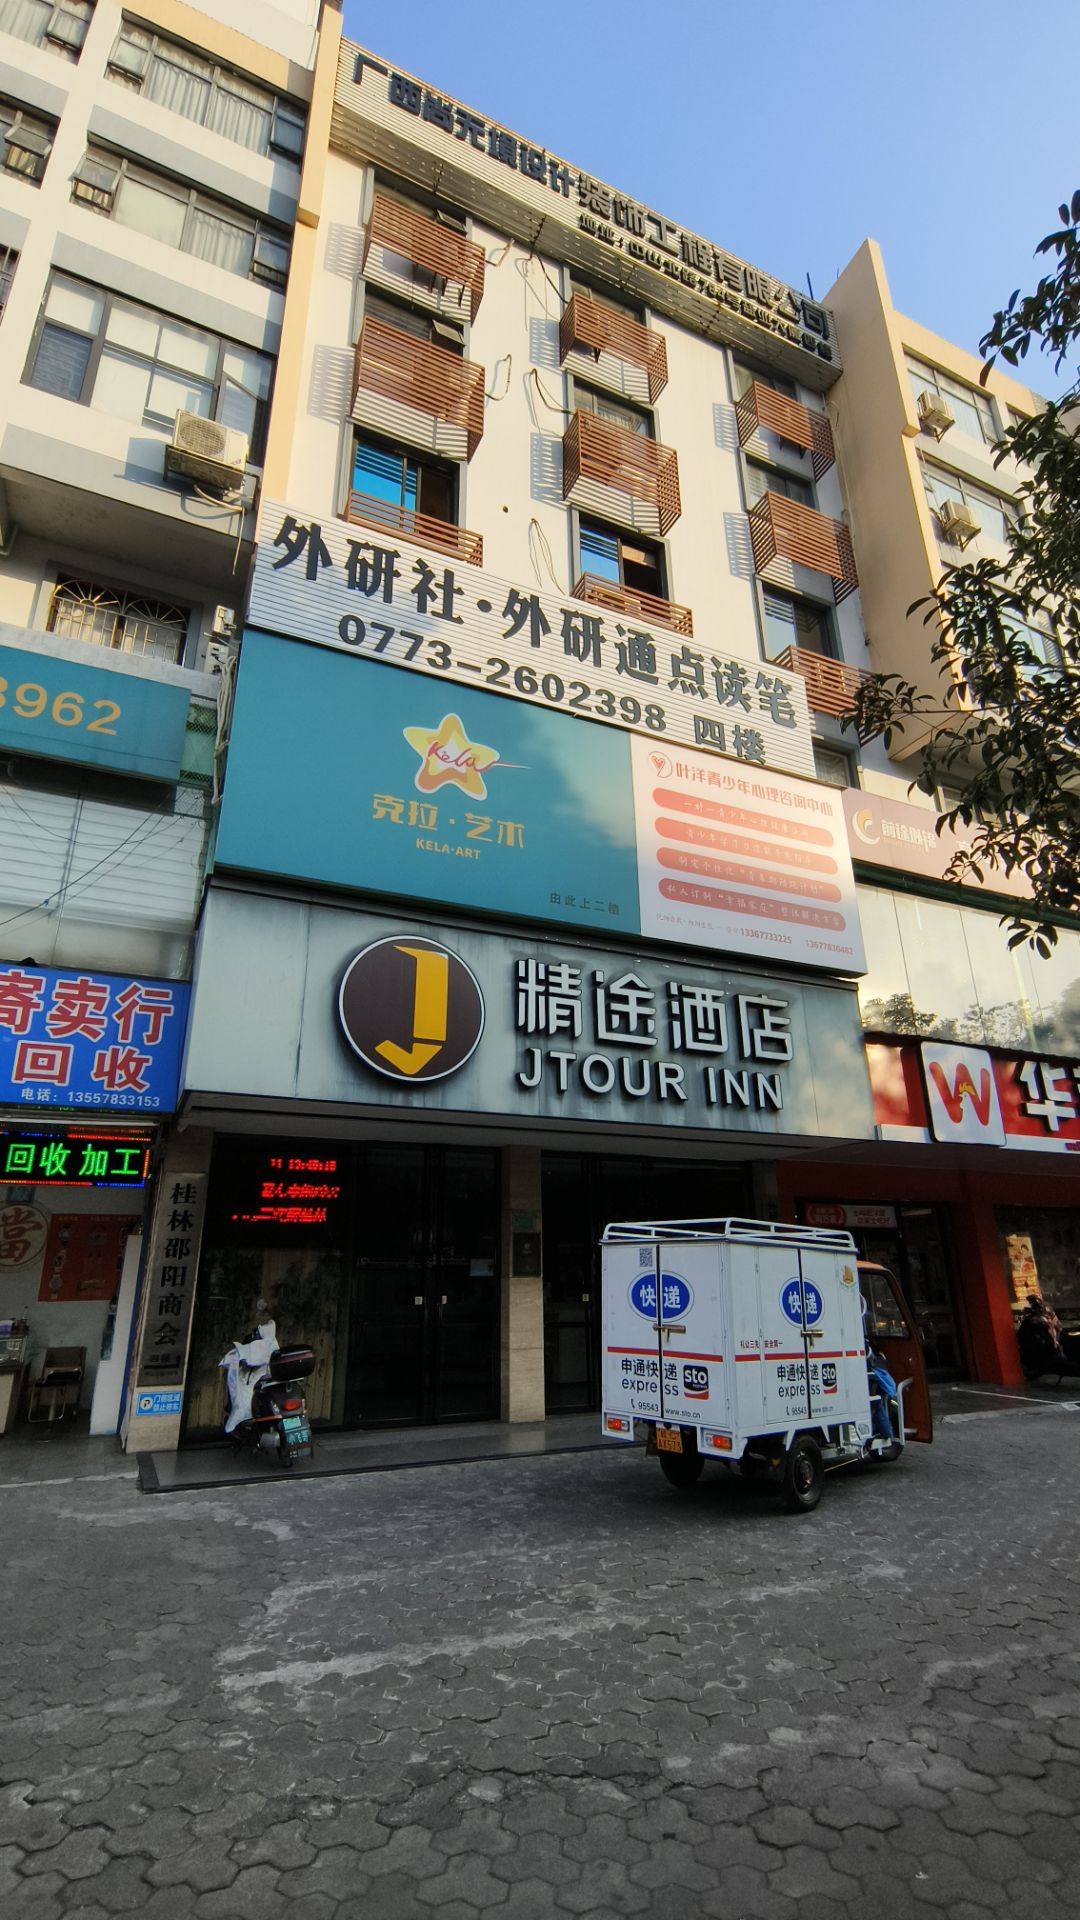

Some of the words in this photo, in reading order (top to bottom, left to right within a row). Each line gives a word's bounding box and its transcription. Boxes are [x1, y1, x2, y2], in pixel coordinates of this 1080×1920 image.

[272, 515, 797, 729] 外研社·外研通点读笔
[0, 676, 121, 736] 962
[339, 614, 667, 733] 0773-2602398
[693, 714, 767, 765] 四楼
[0, 970, 174, 1045] 寄卖行
[515, 957, 794, 1062] 精途酒店
[11, 1040, 153, 1093] 回收
[518, 1047, 689, 1101] JTOUR
[704, 1065, 785, 1111] INN
[1019, 1060, 1080, 1132] 华
[152, 1182, 198, 1346] 桂林邵阳商会
[640, 1283, 681, 1309] 快递
[788, 1290, 818, 1315] 快递
[621, 1358, 678, 1381] 申通快递
[622, 1378, 679, 1397] express
[684, 1368, 708, 1384] sto
[777, 1363, 819, 1382] 申通快递
[822, 1368, 836, 1380] sto
[638, 1401, 659, 1412] 95543
[778, 1384, 820, 1400] express
